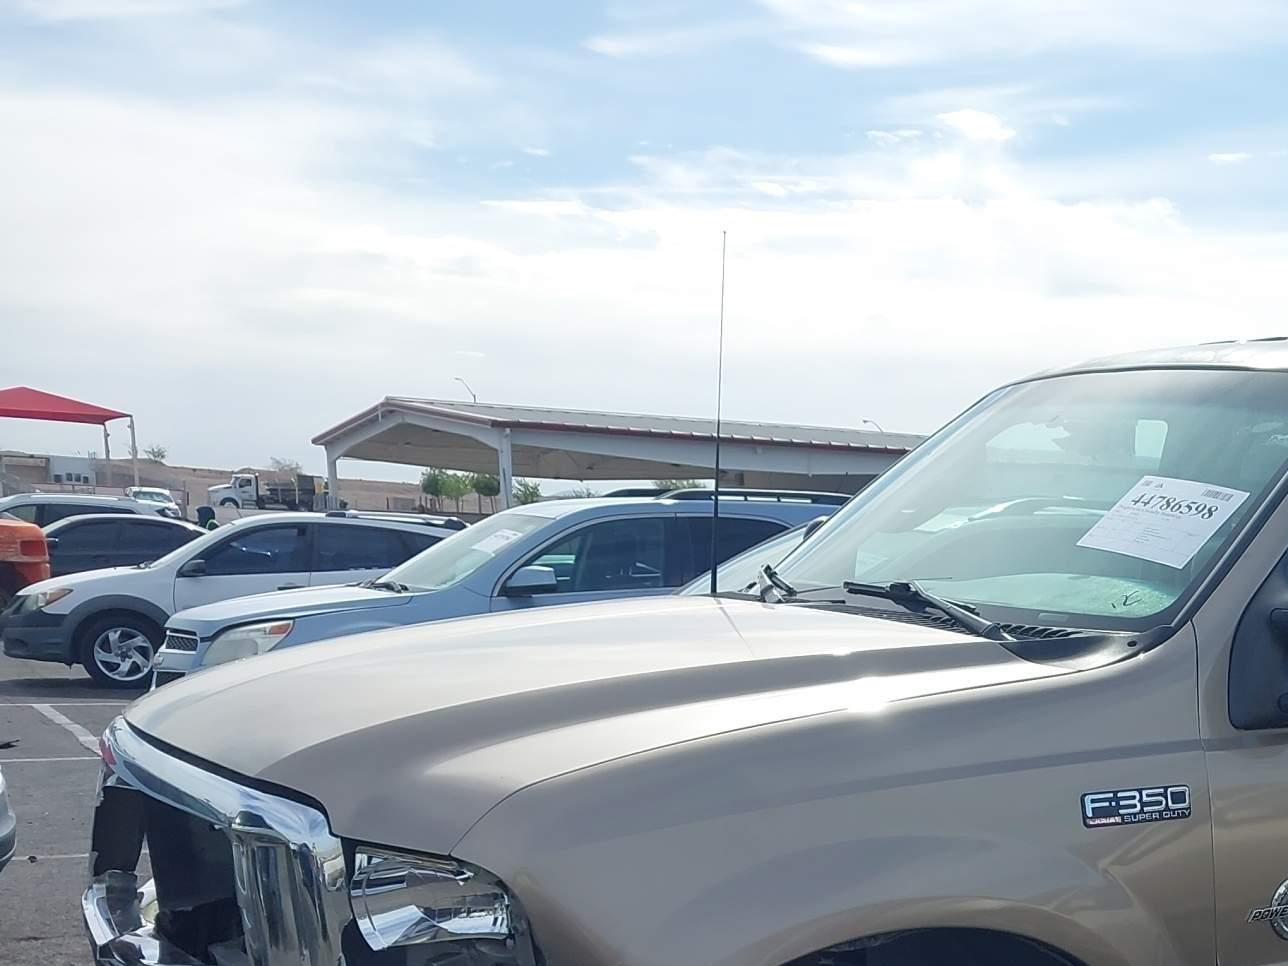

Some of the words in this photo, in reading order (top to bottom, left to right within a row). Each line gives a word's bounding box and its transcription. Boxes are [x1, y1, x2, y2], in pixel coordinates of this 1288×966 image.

[1131, 492, 1219, 520] 44786598
[1123, 812, 1160, 823] SUPER
[1162, 809, 1191, 818] DUTY
